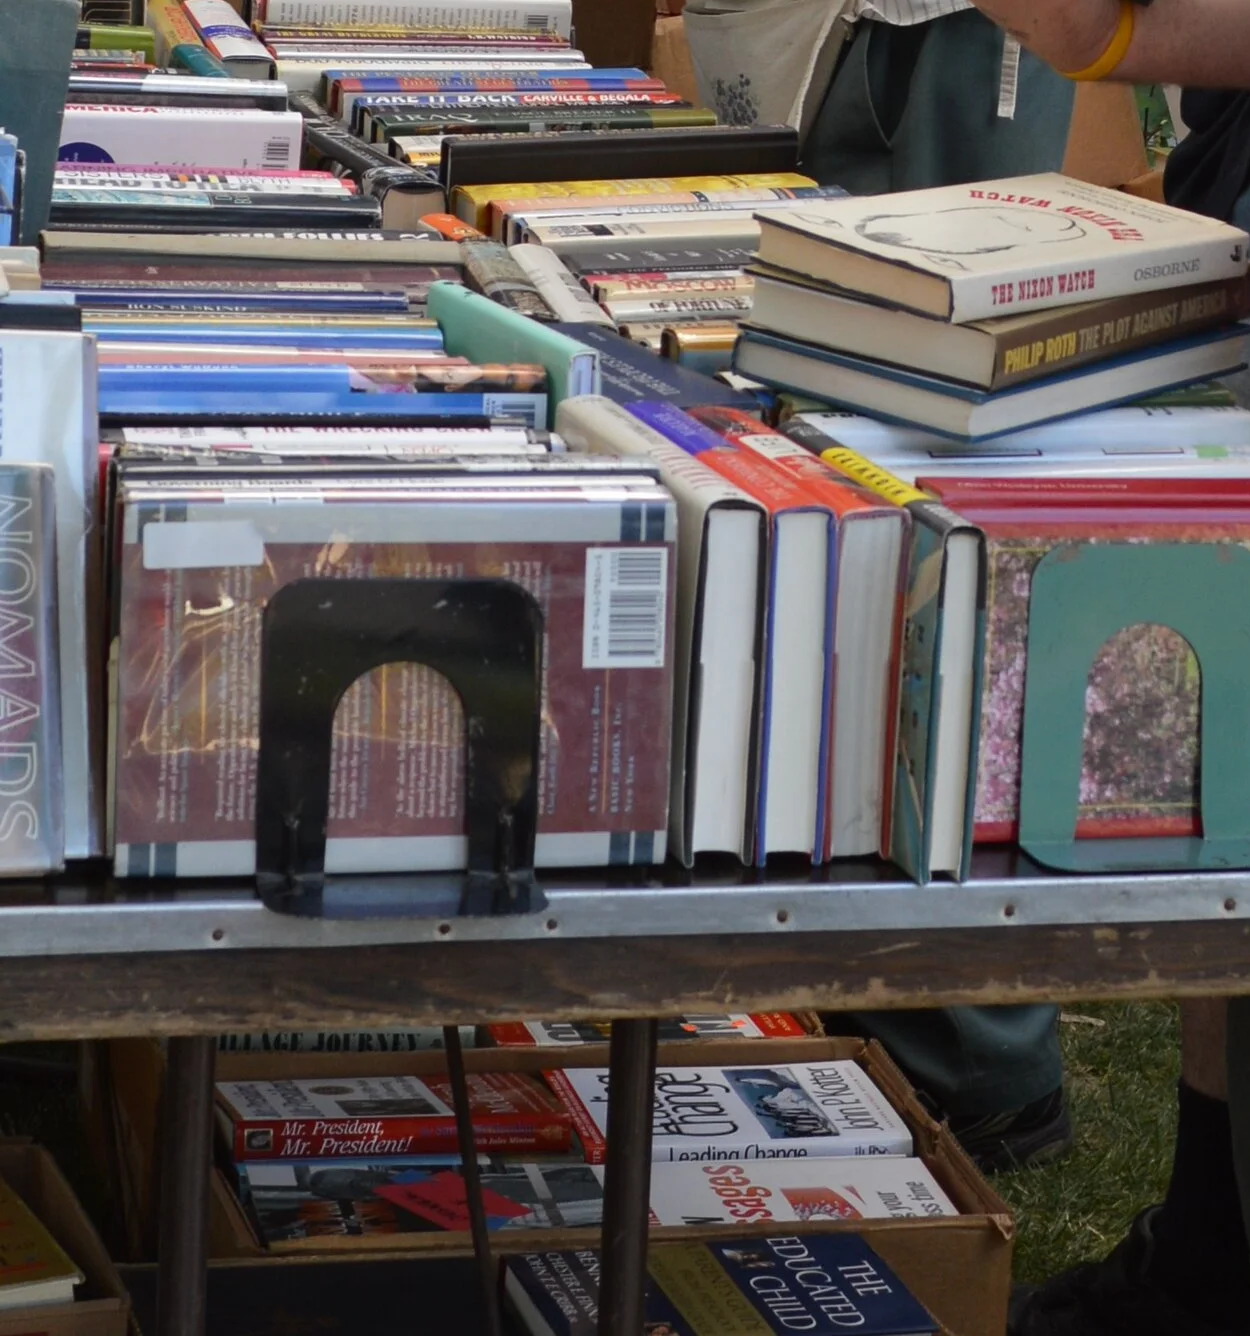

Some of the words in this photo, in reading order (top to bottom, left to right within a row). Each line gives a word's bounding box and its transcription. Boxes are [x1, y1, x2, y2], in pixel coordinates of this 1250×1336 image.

[366, 95, 418, 104] TAKE
[429, 95, 444, 104] IT
[458, 94, 516, 104] BACK
[524, 94, 584, 102] CARVILLE
[600, 94, 650, 102] BEGALA
[968, 189, 1053, 208] WATCH
[991, 284, 1013, 305] THE
[1018, 277, 1053, 302] NIXON
[1057, 269, 1096, 295] WATCH
[1134, 258, 1200, 282] OSBORNE
[1004, 341, 1043, 375] PHILIP
[1045, 332, 1077, 363] ROTH
[1079, 326, 1100, 353] THE
[1102, 317, 1131, 346] PLOT
[1133, 306, 1178, 336] AGAINST
[1179, 293, 1228, 325] AMERICA
[217, 1031, 304, 1053] ILLAGE
[281, 1119, 307, 1136] Mr.
[312, 1118, 385, 1138] President,
[280, 1137, 309, 1155] Mr.
[316, 1135, 413, 1155] President!
[669, 1146, 740, 1161] Leading
[744, 1143, 807, 1159] Change
[765, 1236, 866, 1330] EDUCATED
[838, 1259, 892, 1299] THE
[748, 1275, 817, 1332] CHILD
